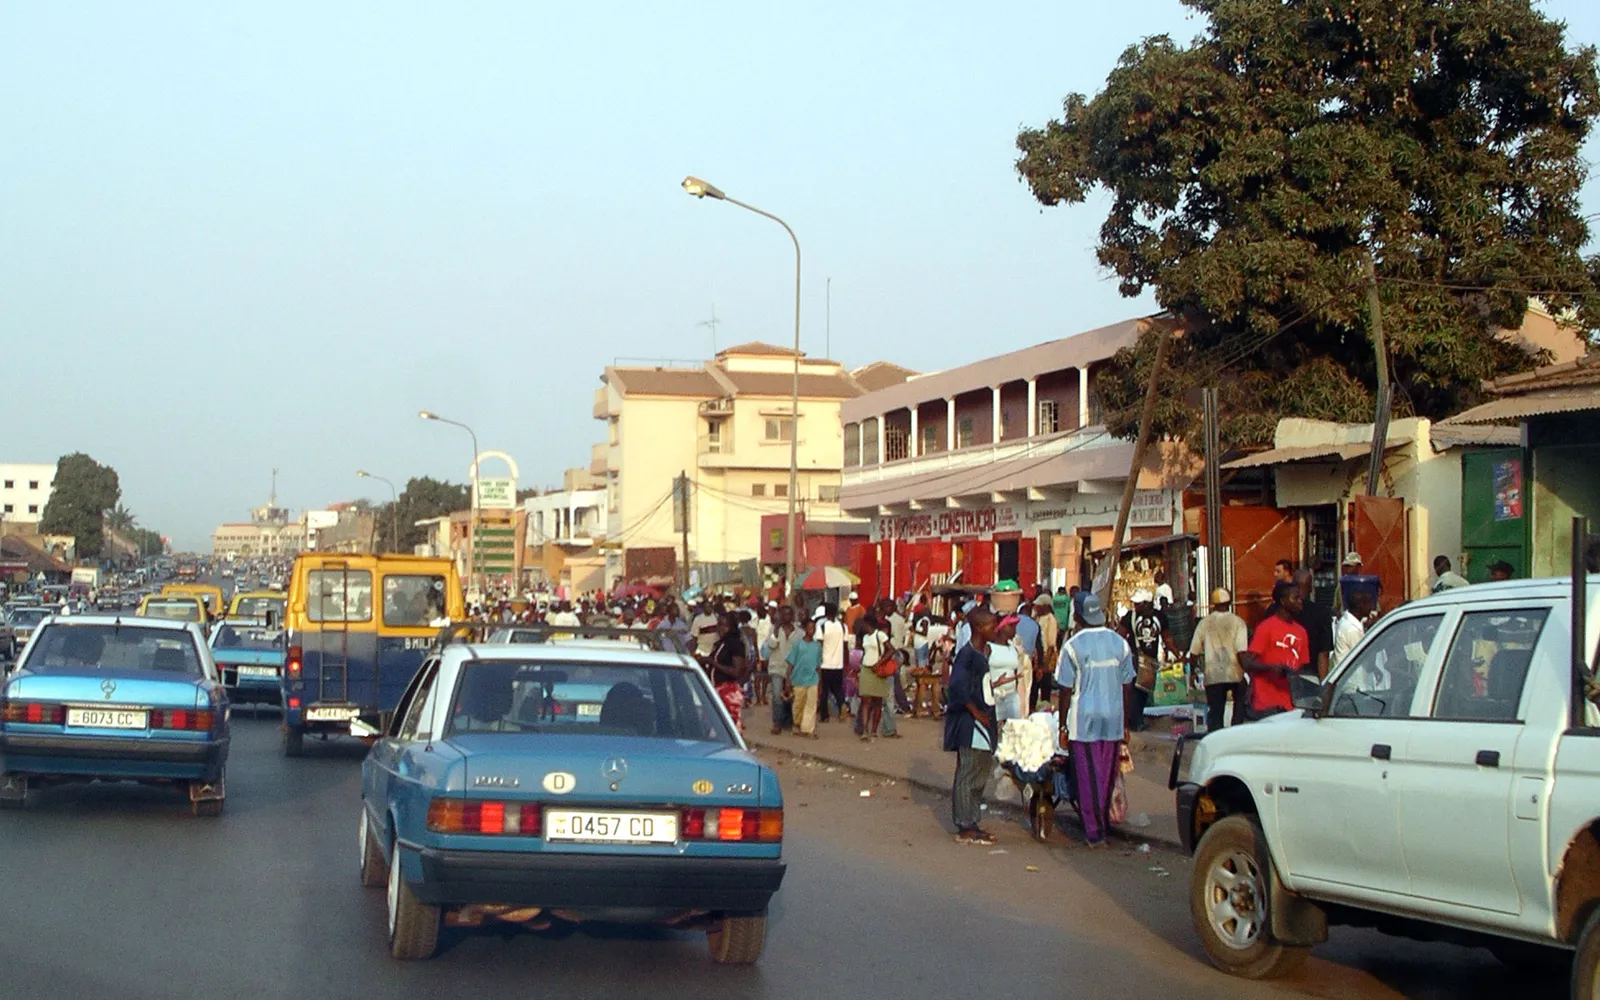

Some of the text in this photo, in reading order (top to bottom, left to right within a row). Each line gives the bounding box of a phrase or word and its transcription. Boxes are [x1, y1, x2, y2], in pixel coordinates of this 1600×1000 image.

[82, 711, 132, 725] 6073 CC
[553, 774, 565, 789] D
[571, 816, 621, 836] 0457
